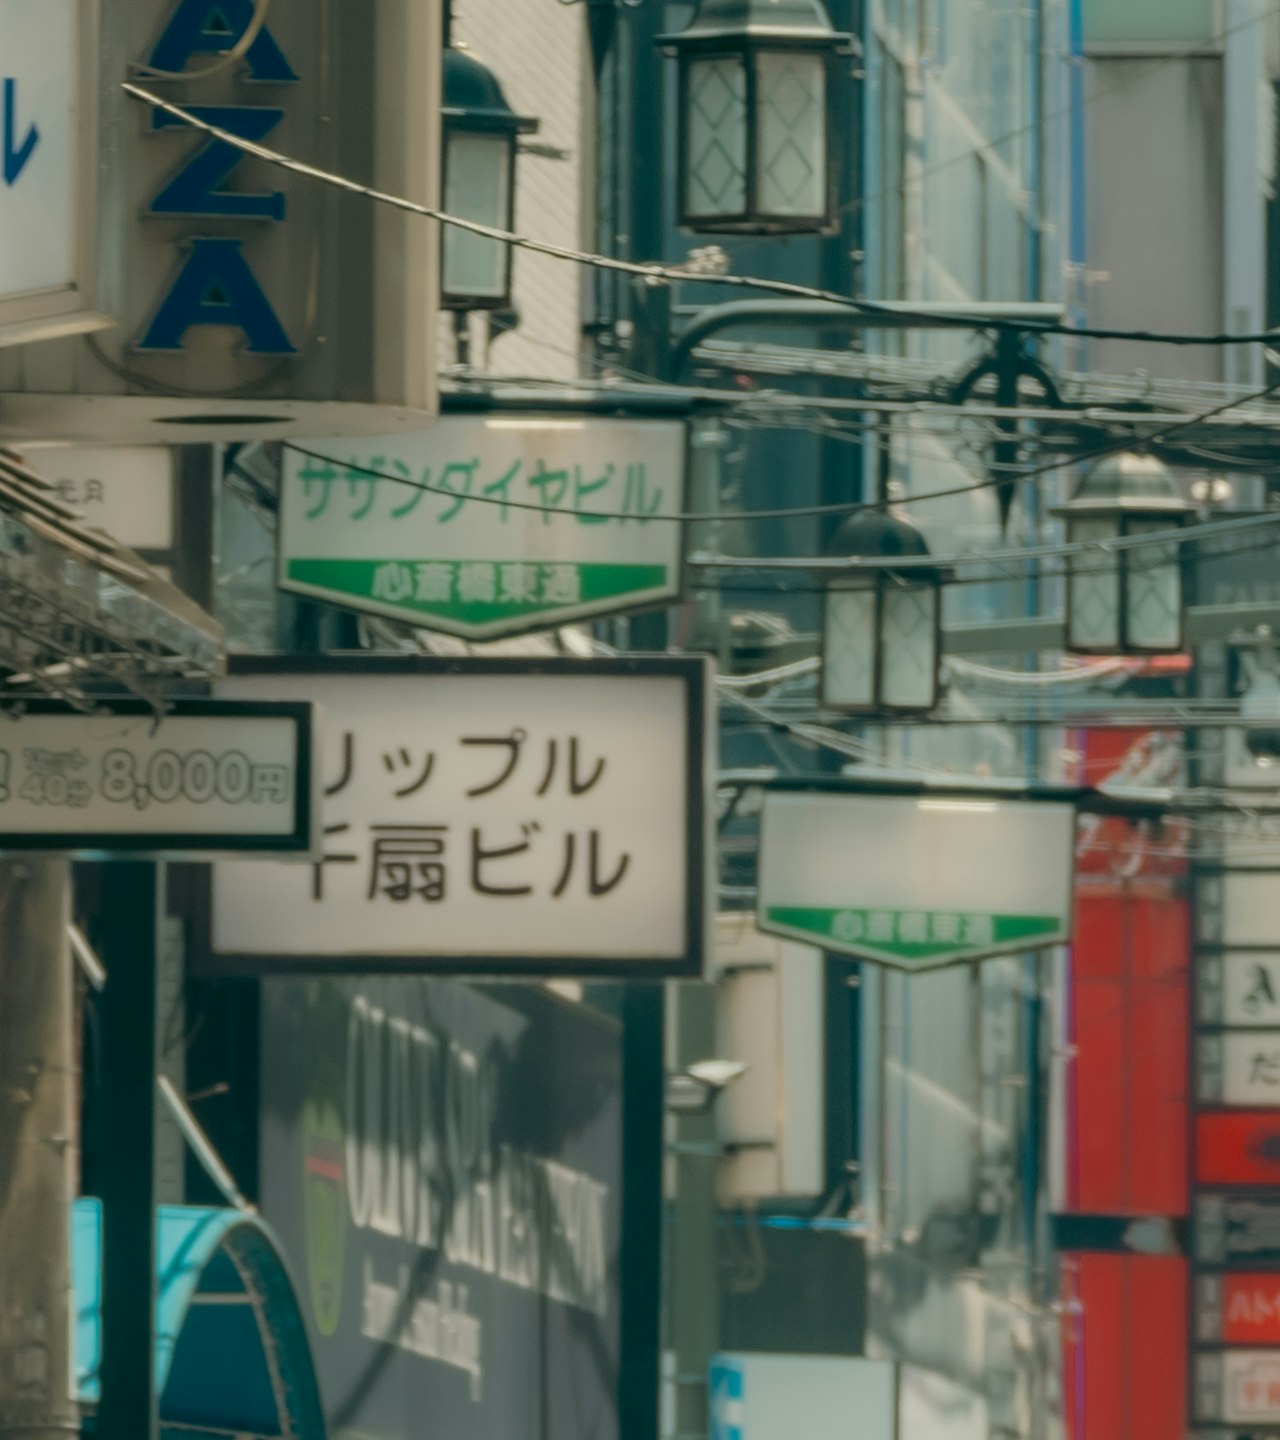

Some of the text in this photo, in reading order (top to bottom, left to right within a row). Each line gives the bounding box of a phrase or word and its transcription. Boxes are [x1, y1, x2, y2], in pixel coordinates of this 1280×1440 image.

[295, 456, 663, 528] サザンダイヤビル
[372, 563, 582, 606] 心斎橋東通
[99, 747, 289, 810] 8,000円
